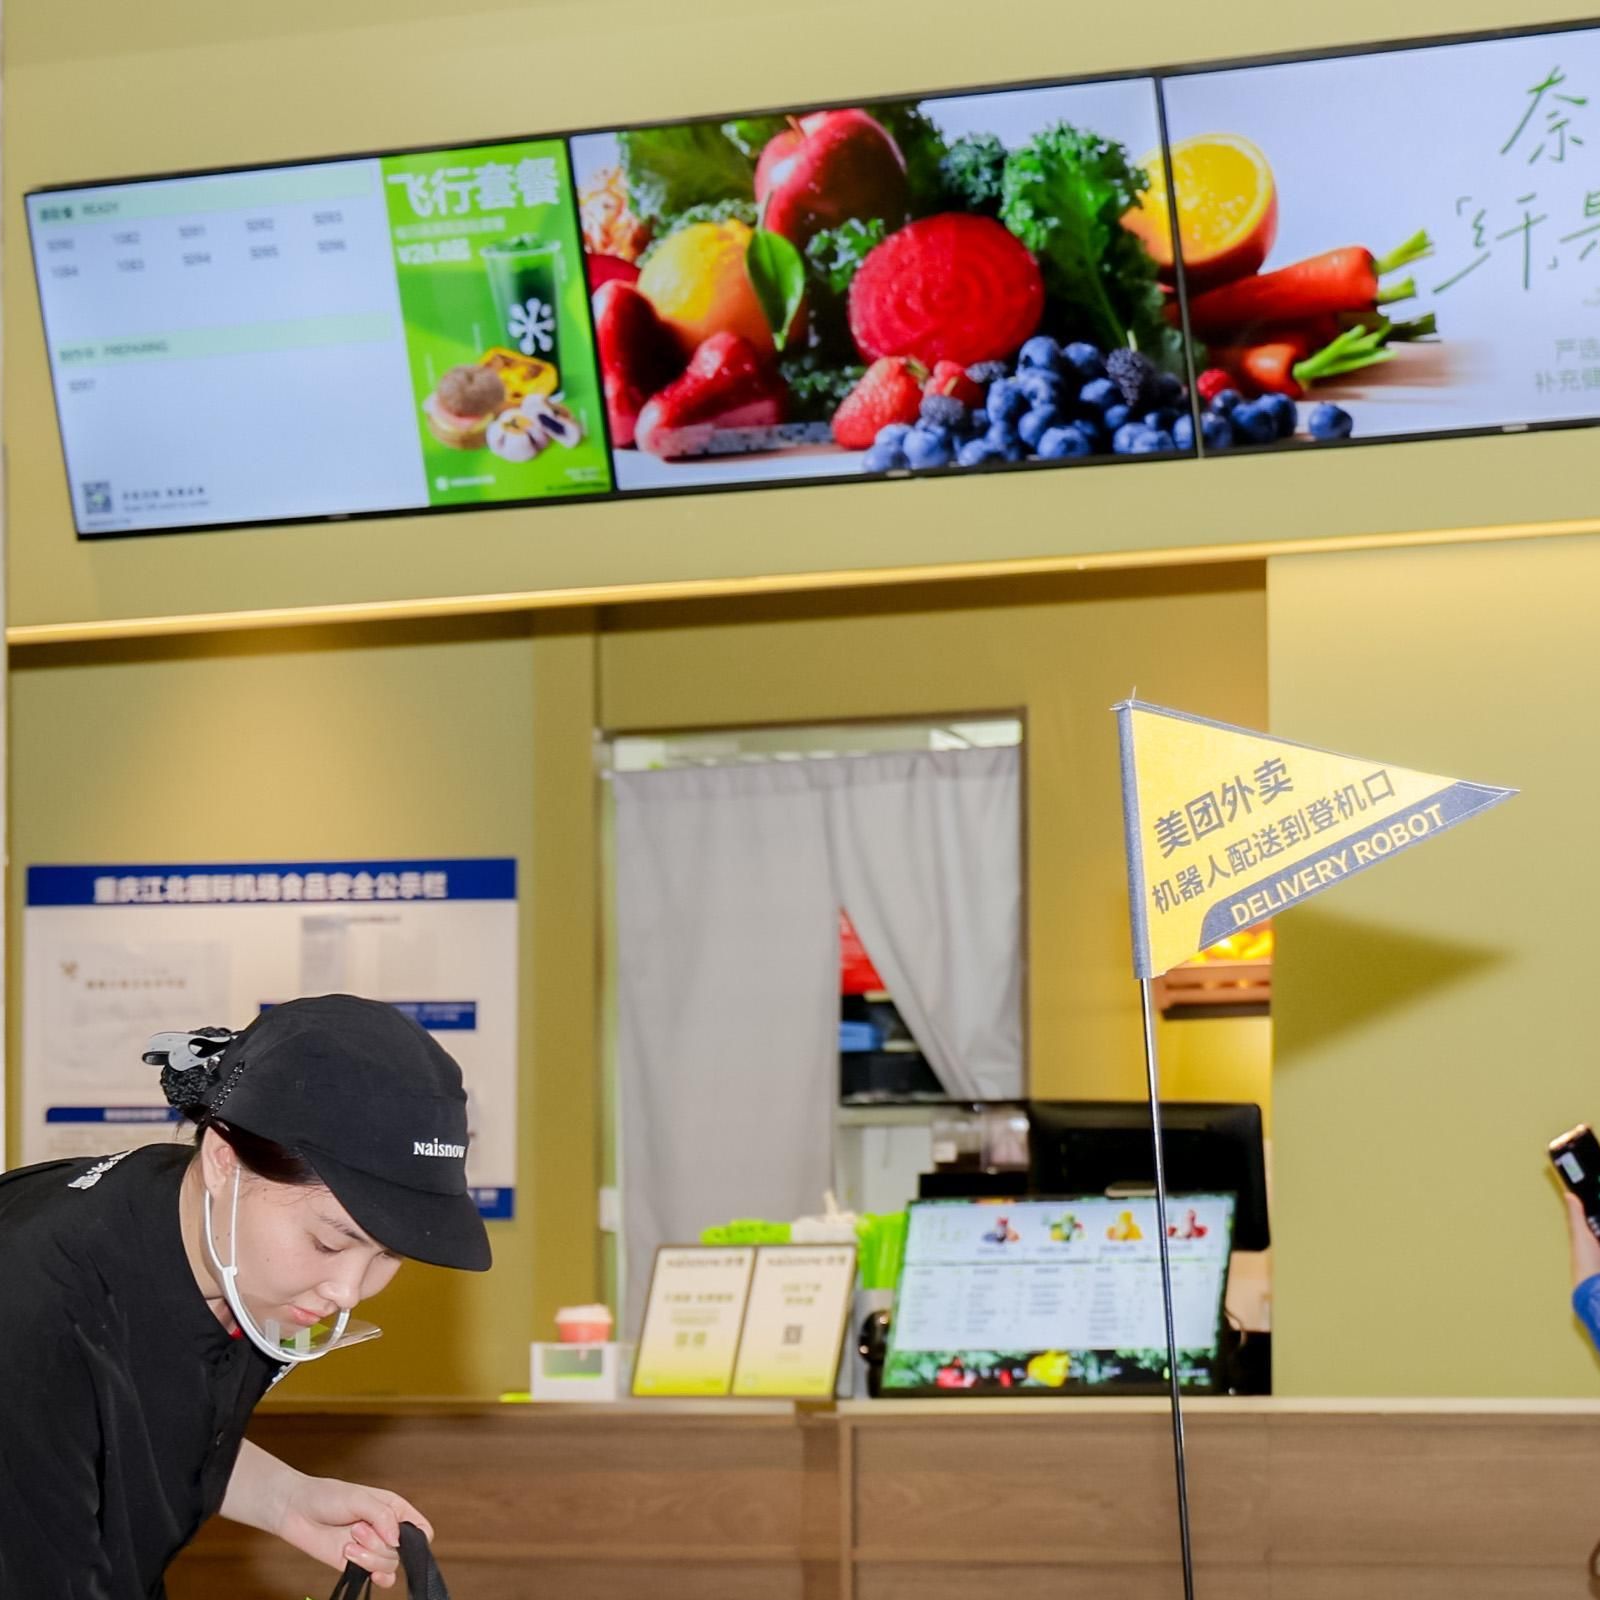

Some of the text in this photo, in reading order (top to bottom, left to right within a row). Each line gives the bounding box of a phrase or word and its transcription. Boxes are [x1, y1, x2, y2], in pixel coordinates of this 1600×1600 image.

[387, 157, 561, 218] 飞行套餐
[1152, 769, 1396, 915] 机器人配送到登机口
[1153, 756, 1296, 859] 美团外卖
[1230, 803, 1447, 927] DELIVERY ROBOT
[413, 1137, 466, 1159] Naisnow
